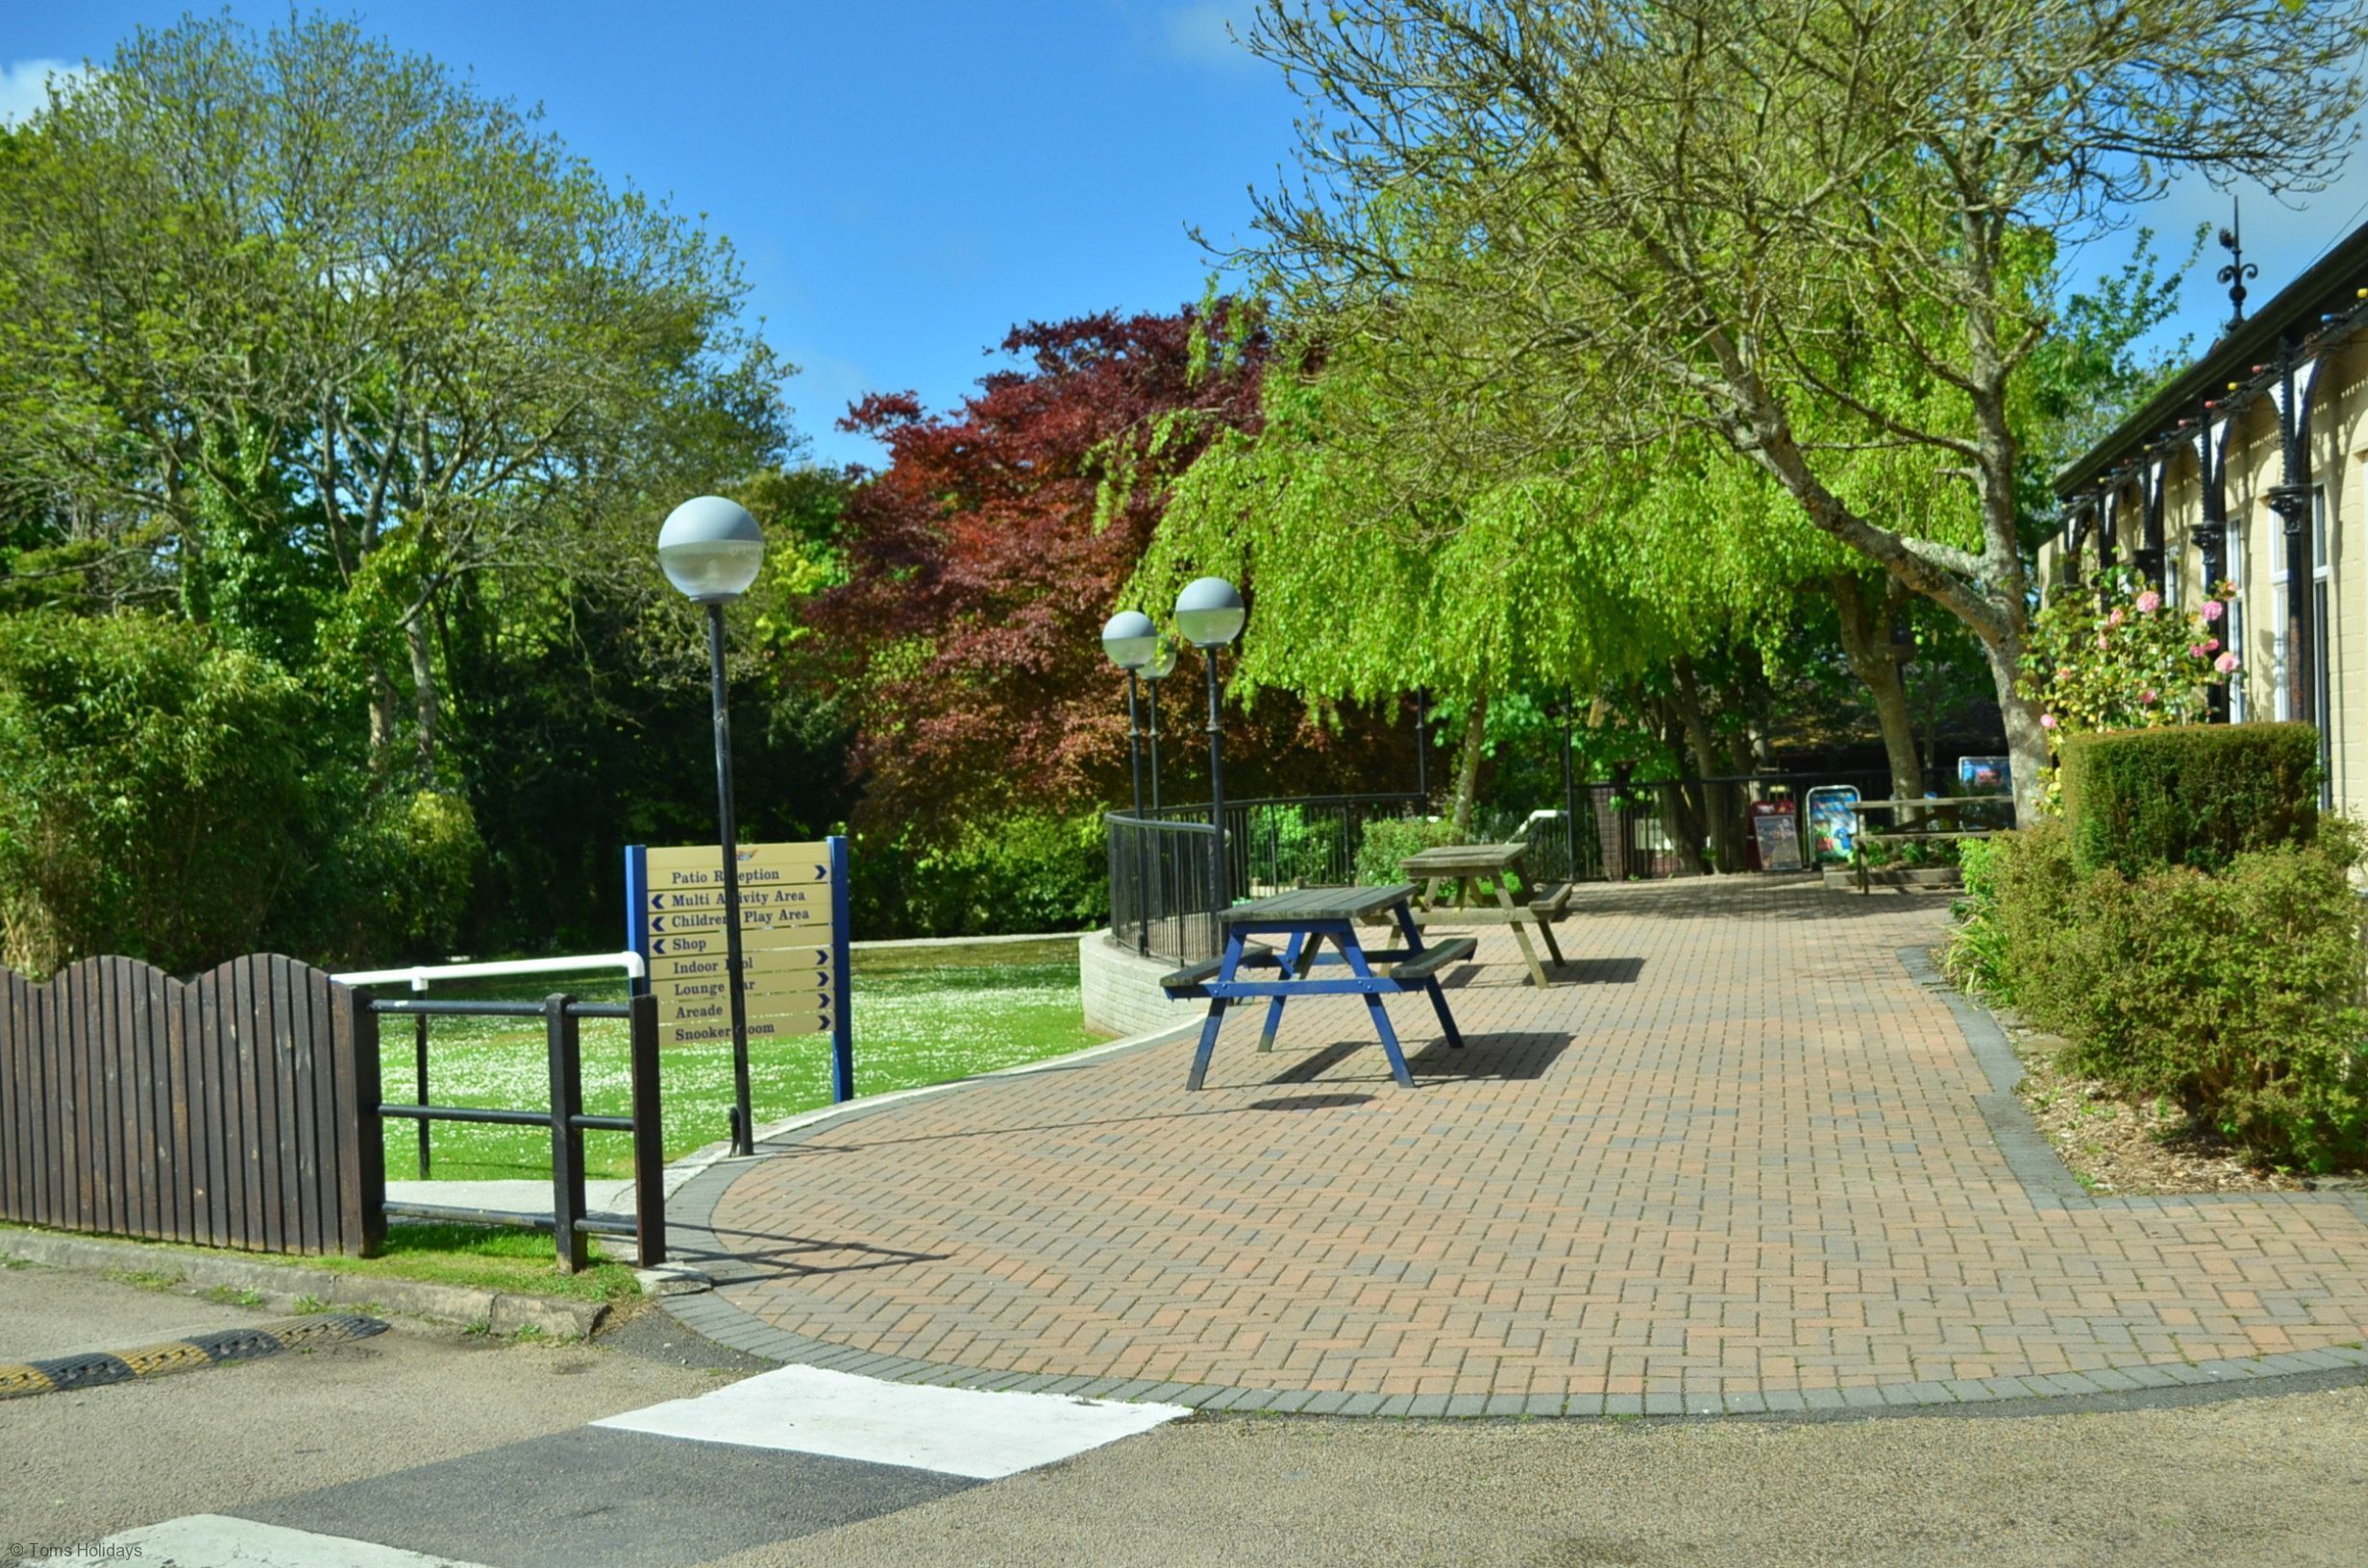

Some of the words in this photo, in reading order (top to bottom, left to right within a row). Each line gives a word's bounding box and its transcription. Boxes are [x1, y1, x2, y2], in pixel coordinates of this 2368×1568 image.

[672, 870, 708, 885] Patio
[713, 869, 780, 884] Reption
[672, 894, 710, 907] Multi
[716, 891, 770, 906] Aivity
[775, 890, 806, 902] Area
[744, 911, 774, 924] Play
[778, 909, 810, 921] Area
[673, 938, 707, 952] Shop
[673, 960, 719, 974] Indoor
[674, 982, 726, 996] Lounge
[676, 1004, 724, 1018] Arcade
[675, 1025, 731, 1041] Snooker
[747, 1022, 776, 1035] oom
